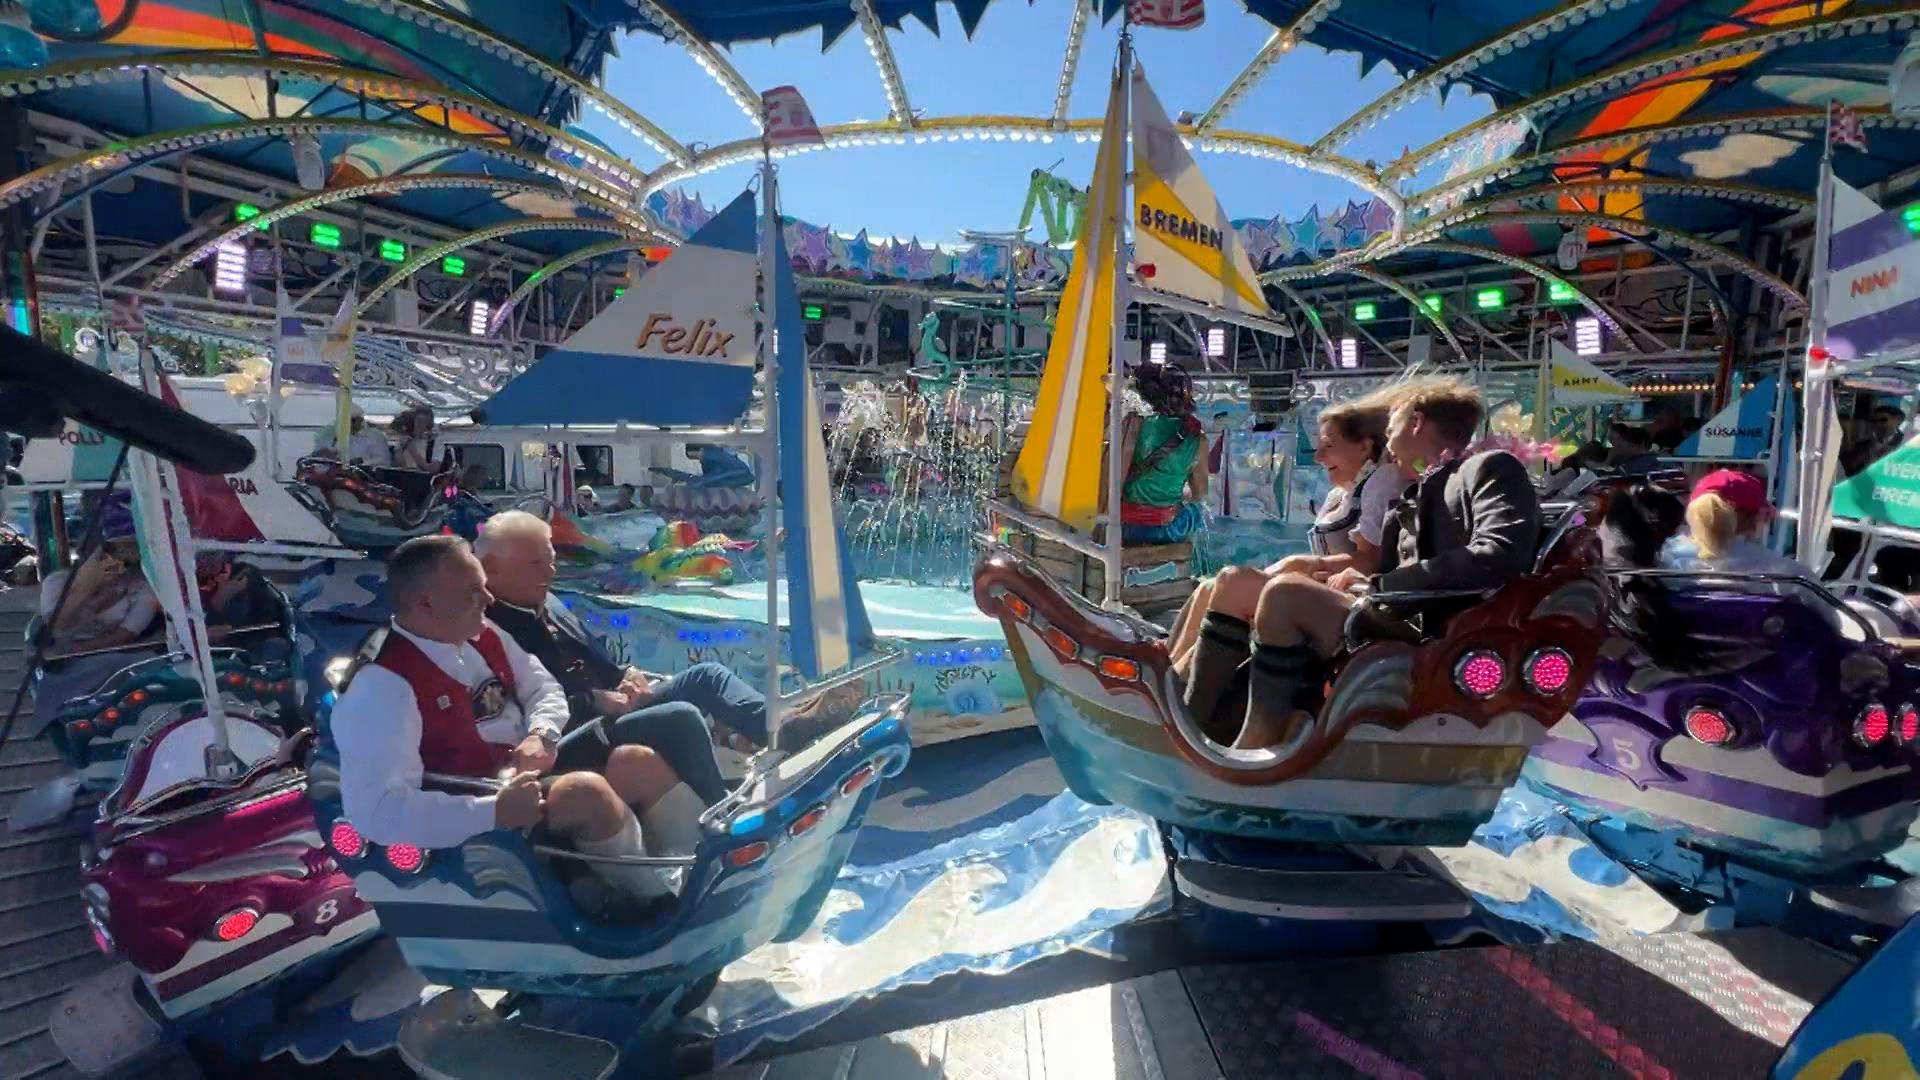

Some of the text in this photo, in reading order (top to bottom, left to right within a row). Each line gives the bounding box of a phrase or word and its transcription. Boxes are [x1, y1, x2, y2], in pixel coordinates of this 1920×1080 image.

[1140, 203, 1224, 251] BREMEN
[637, 311, 735, 357] Felix
[228, 477, 258, 495] RIA
[1612, 737, 1640, 770] 5
[314, 899, 338, 924] 8
